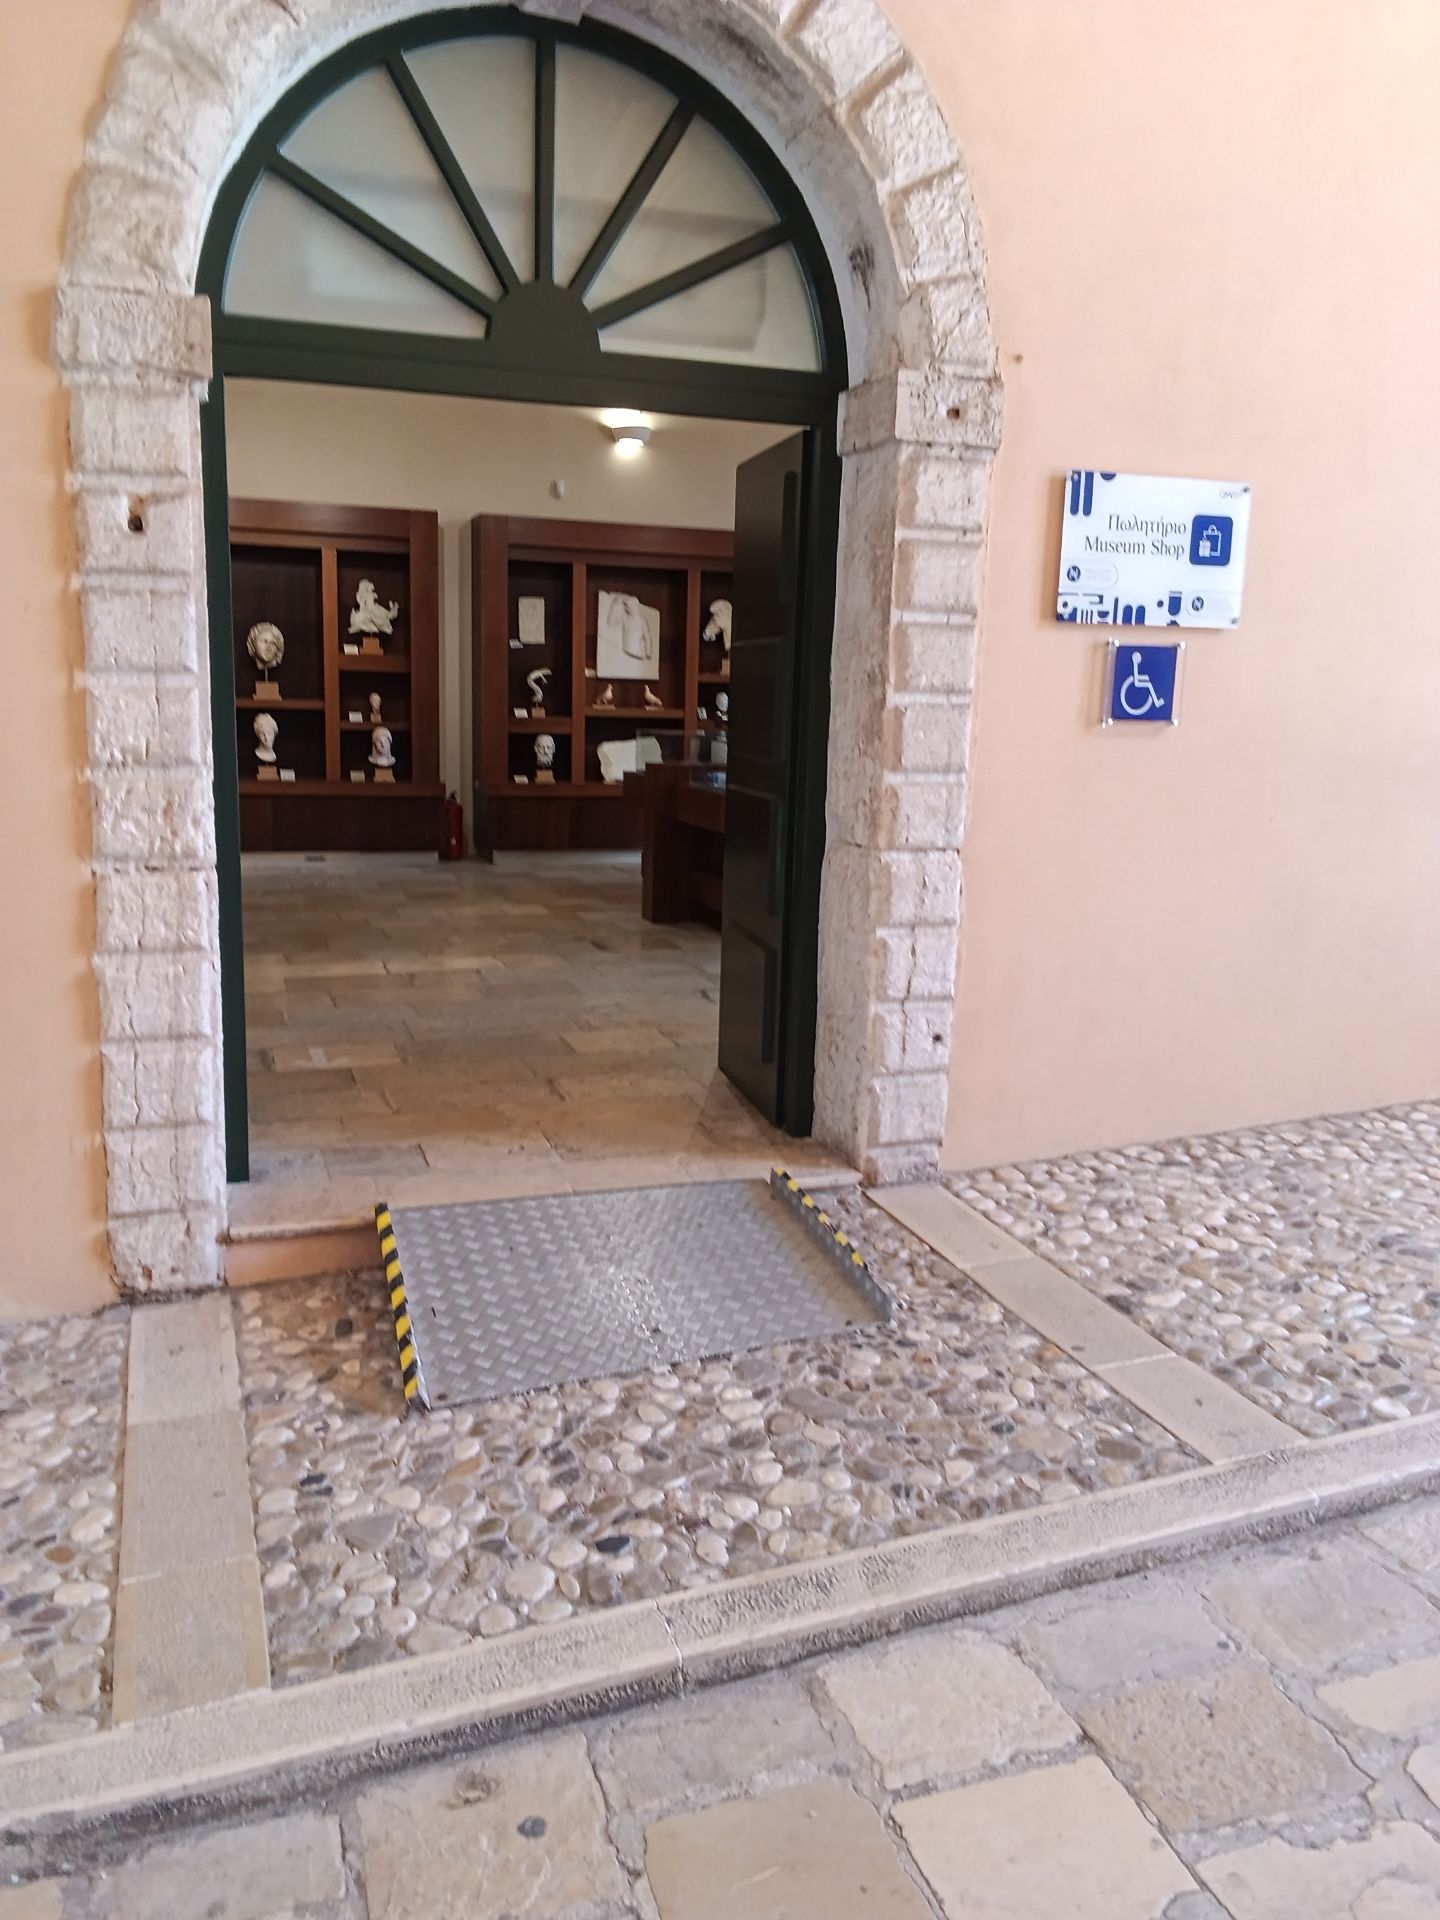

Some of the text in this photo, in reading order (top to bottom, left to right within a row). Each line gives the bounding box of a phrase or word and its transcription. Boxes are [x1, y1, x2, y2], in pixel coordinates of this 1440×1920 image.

[1108, 514, 1187, 537] Πωλητήριο
[1085, 536, 1185, 559] Museum Shop
